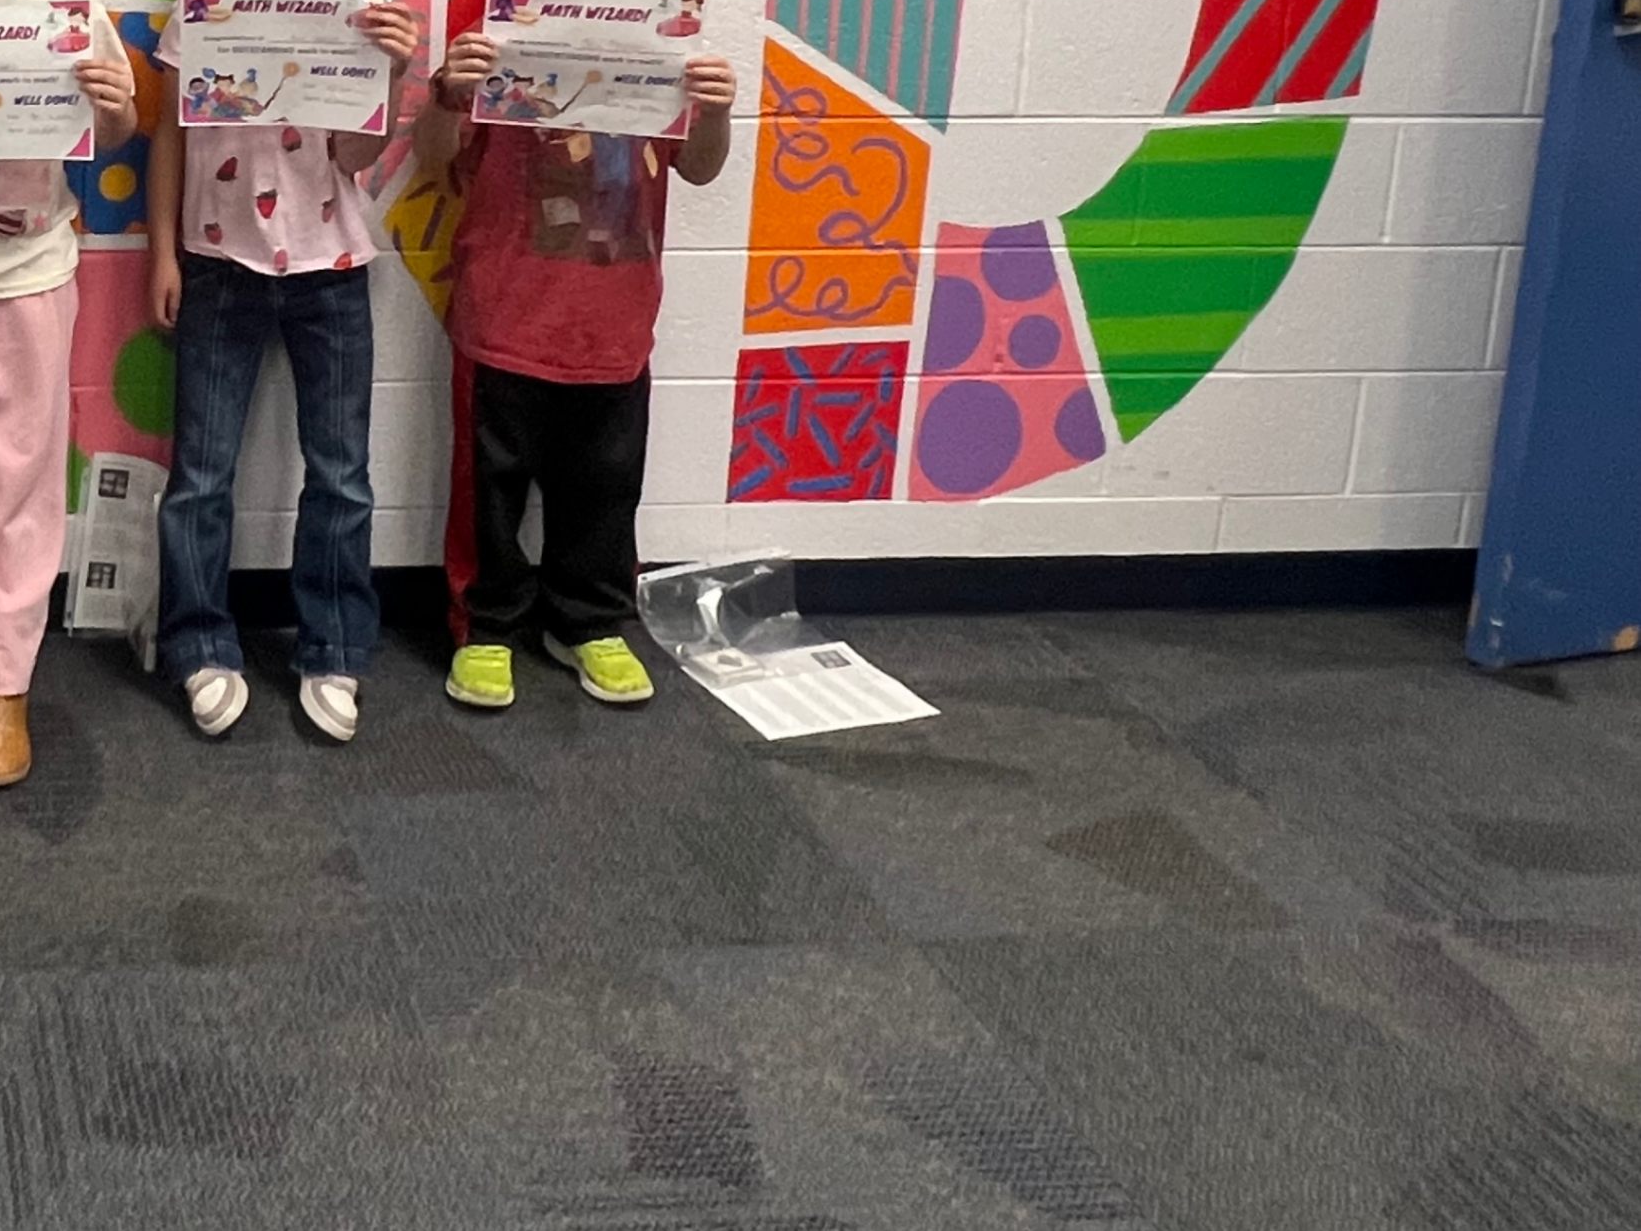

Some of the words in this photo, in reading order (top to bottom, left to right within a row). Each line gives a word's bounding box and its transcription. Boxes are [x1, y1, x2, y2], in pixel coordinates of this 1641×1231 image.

[275, 0, 341, 16] WIZARD!
[539, 3, 584, 18] MATH
[585, 5, 653, 24] WIZARD!
